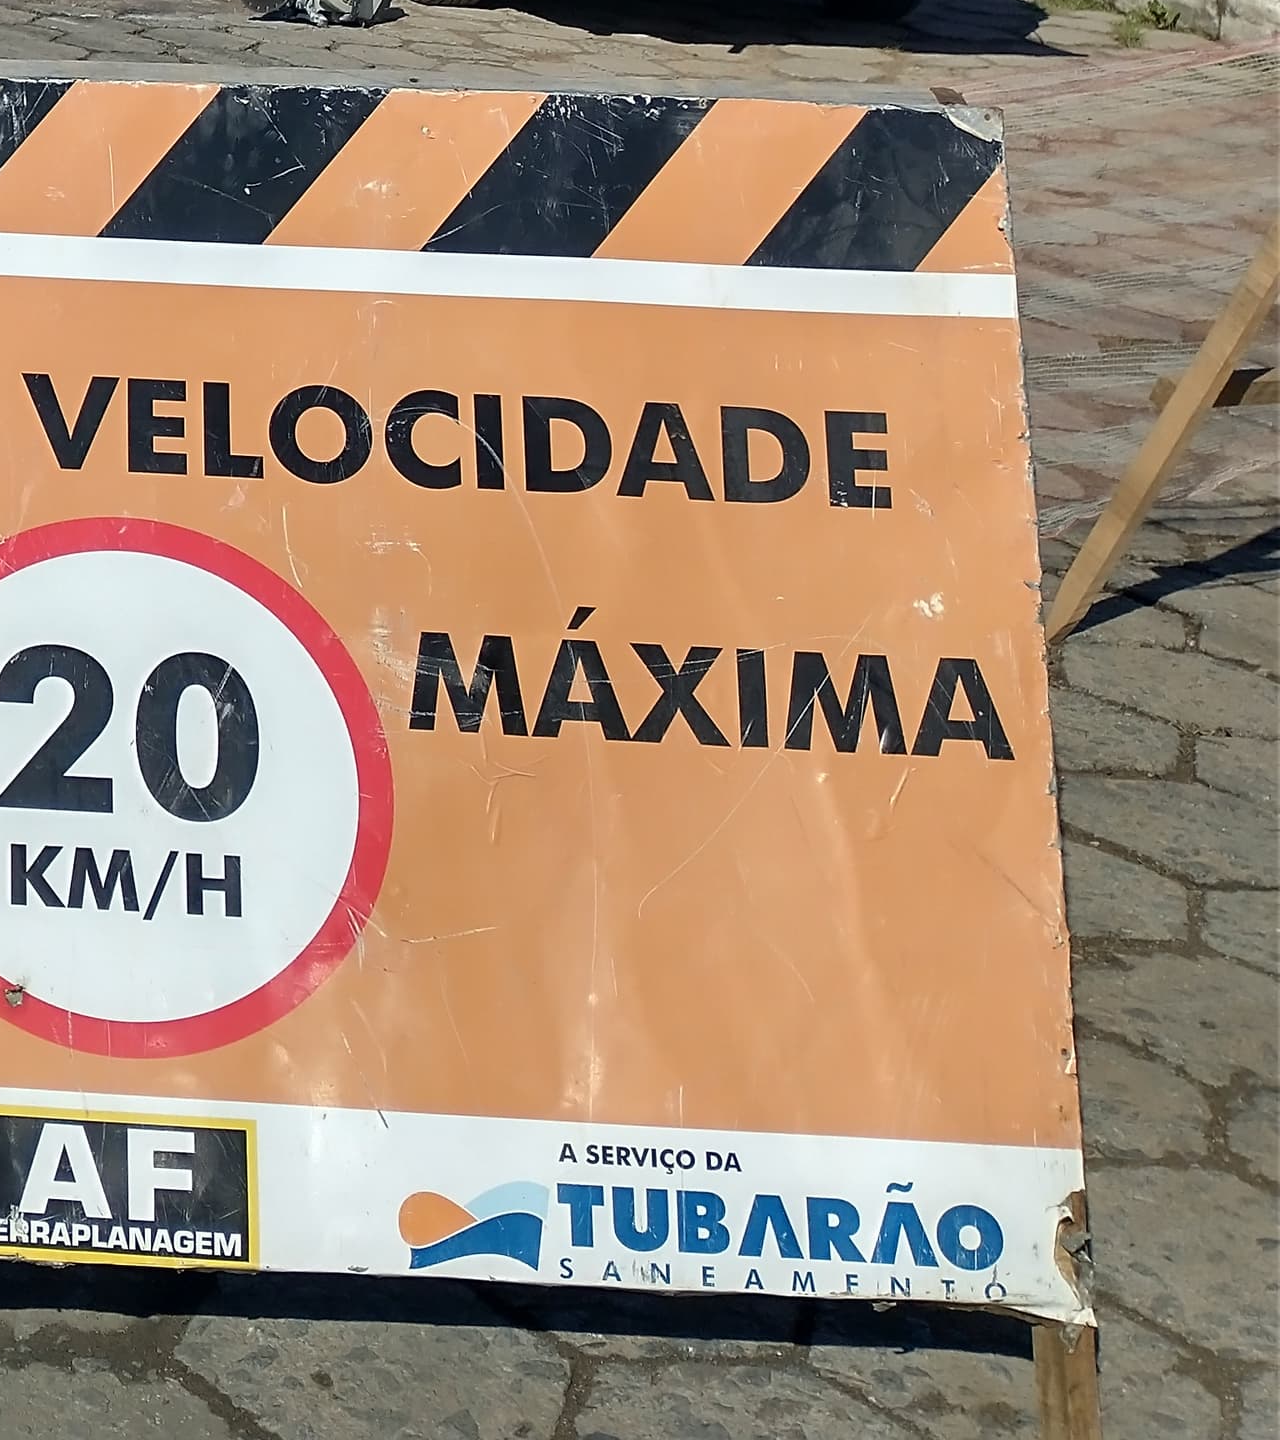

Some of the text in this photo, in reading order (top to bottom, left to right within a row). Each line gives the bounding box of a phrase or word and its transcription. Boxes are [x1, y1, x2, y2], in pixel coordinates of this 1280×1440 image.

[22, 372, 893, 509] VELOCIDADE
[407, 606, 1015, 761] MÁXIMA
[9, 843, 243, 921] KM/H
[18, 1122, 197, 1222] AF
[558, 1142, 742, 1175] A SERVIÇO DA
[556, 1180, 1006, 1273] TUBARÃO
[559, 1257, 1009, 1302] SANEAMENTO
